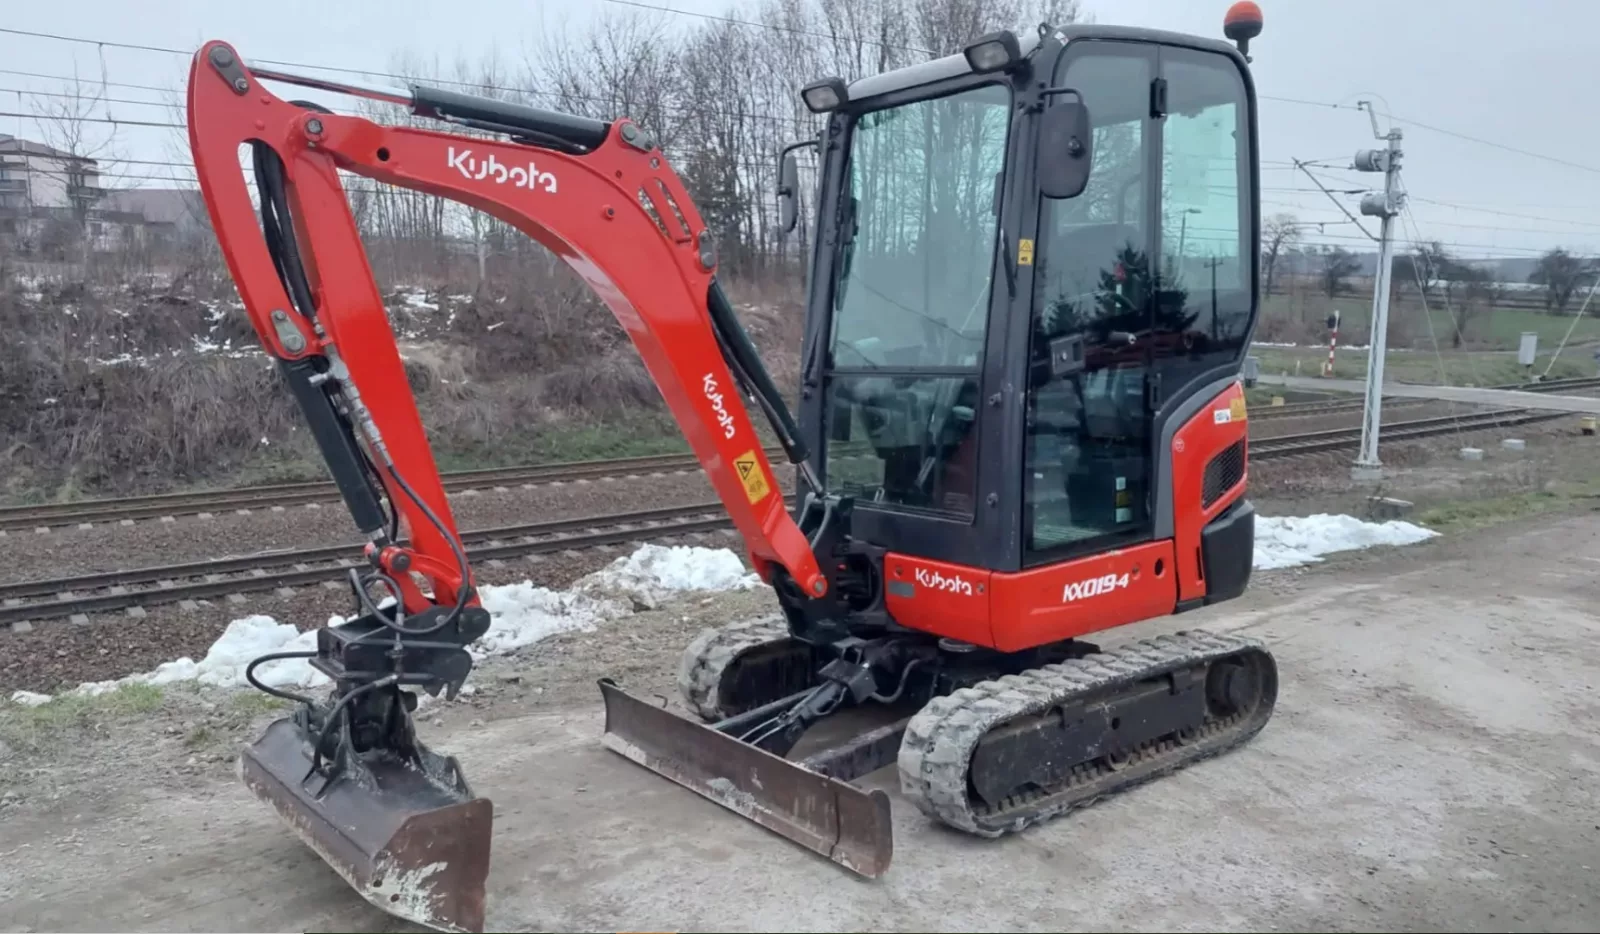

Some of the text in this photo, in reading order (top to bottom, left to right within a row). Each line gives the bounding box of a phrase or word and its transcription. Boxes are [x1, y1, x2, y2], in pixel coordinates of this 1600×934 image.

[448, 147, 557, 193] Kubota
[702, 372, 735, 439] Kubota
[915, 567, 972, 595] Kubota
[1063, 573, 1129, 602] KX019-4
